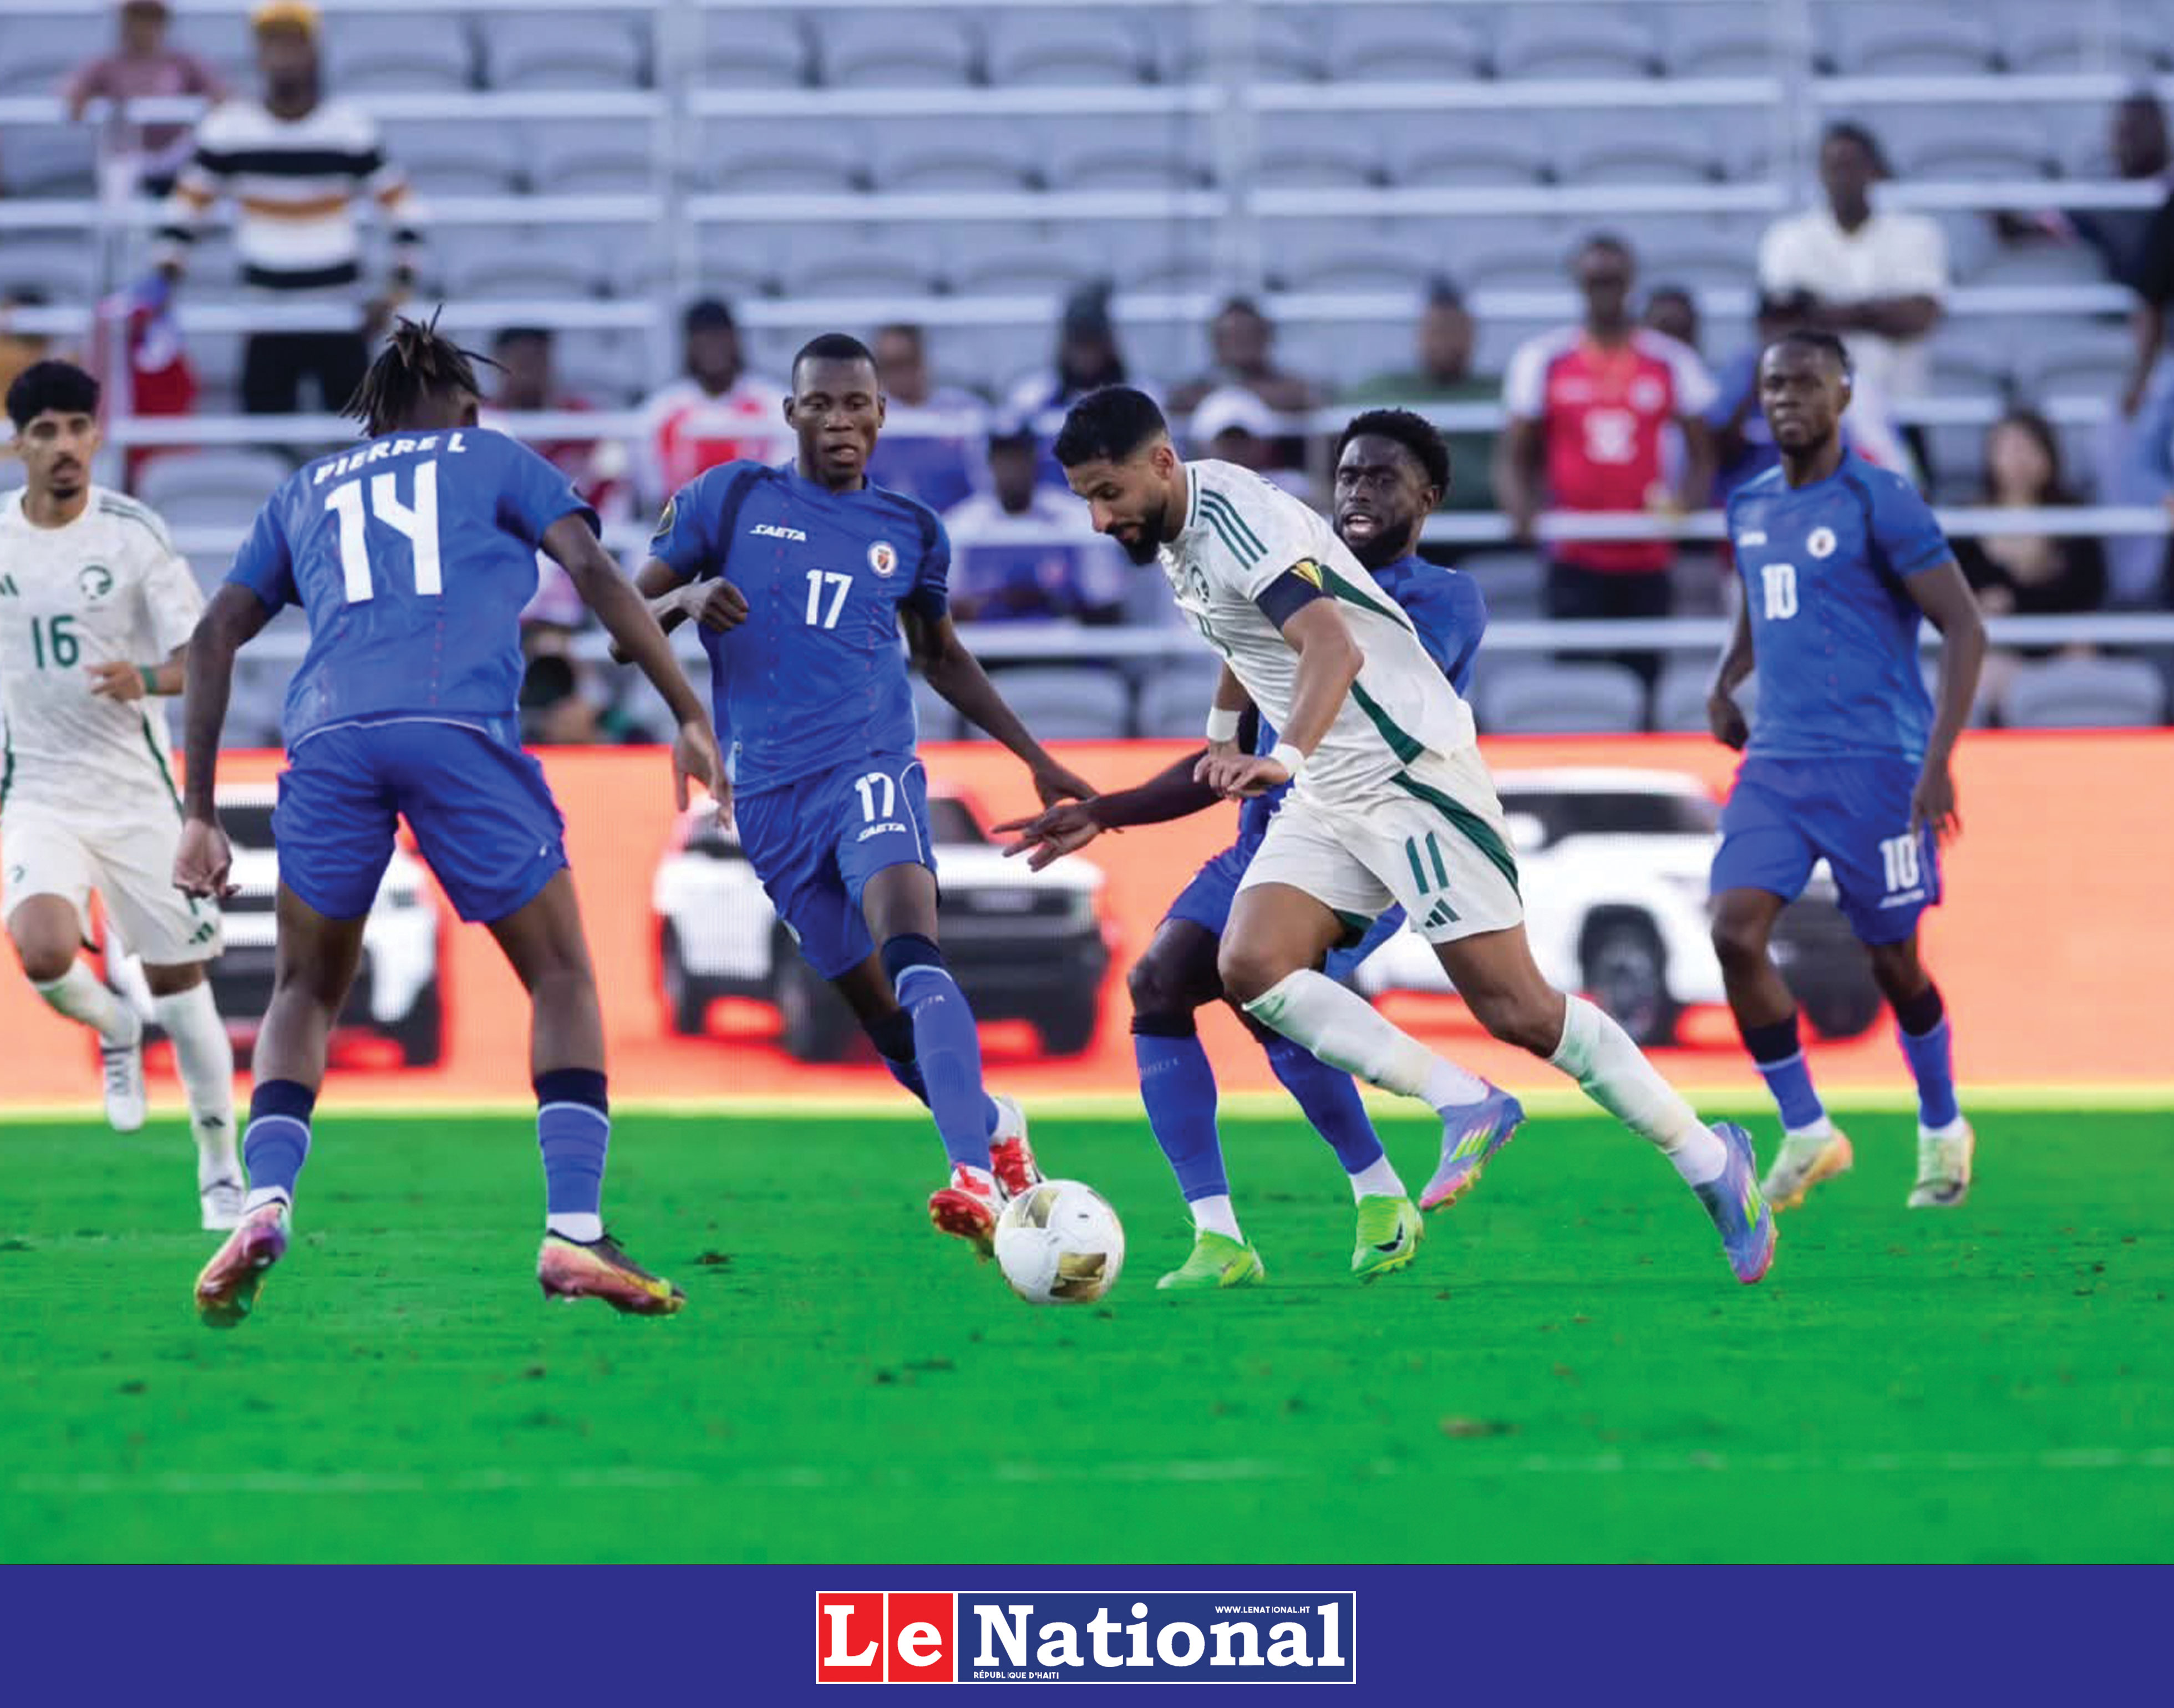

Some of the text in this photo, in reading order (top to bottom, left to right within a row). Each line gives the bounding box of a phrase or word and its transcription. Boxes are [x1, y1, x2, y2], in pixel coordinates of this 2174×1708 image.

[313, 433, 466, 485] PIERRE L
[324, 460, 443, 603] 14
[749, 524, 806, 542] SAETA
[806, 569, 853, 629] 17
[1760, 564, 1799, 620] 10
[31, 614, 80, 669] 16
[855, 772, 895, 822] 17
[1405, 830, 1450, 895] 11
[1878, 835, 1919, 892] 10
